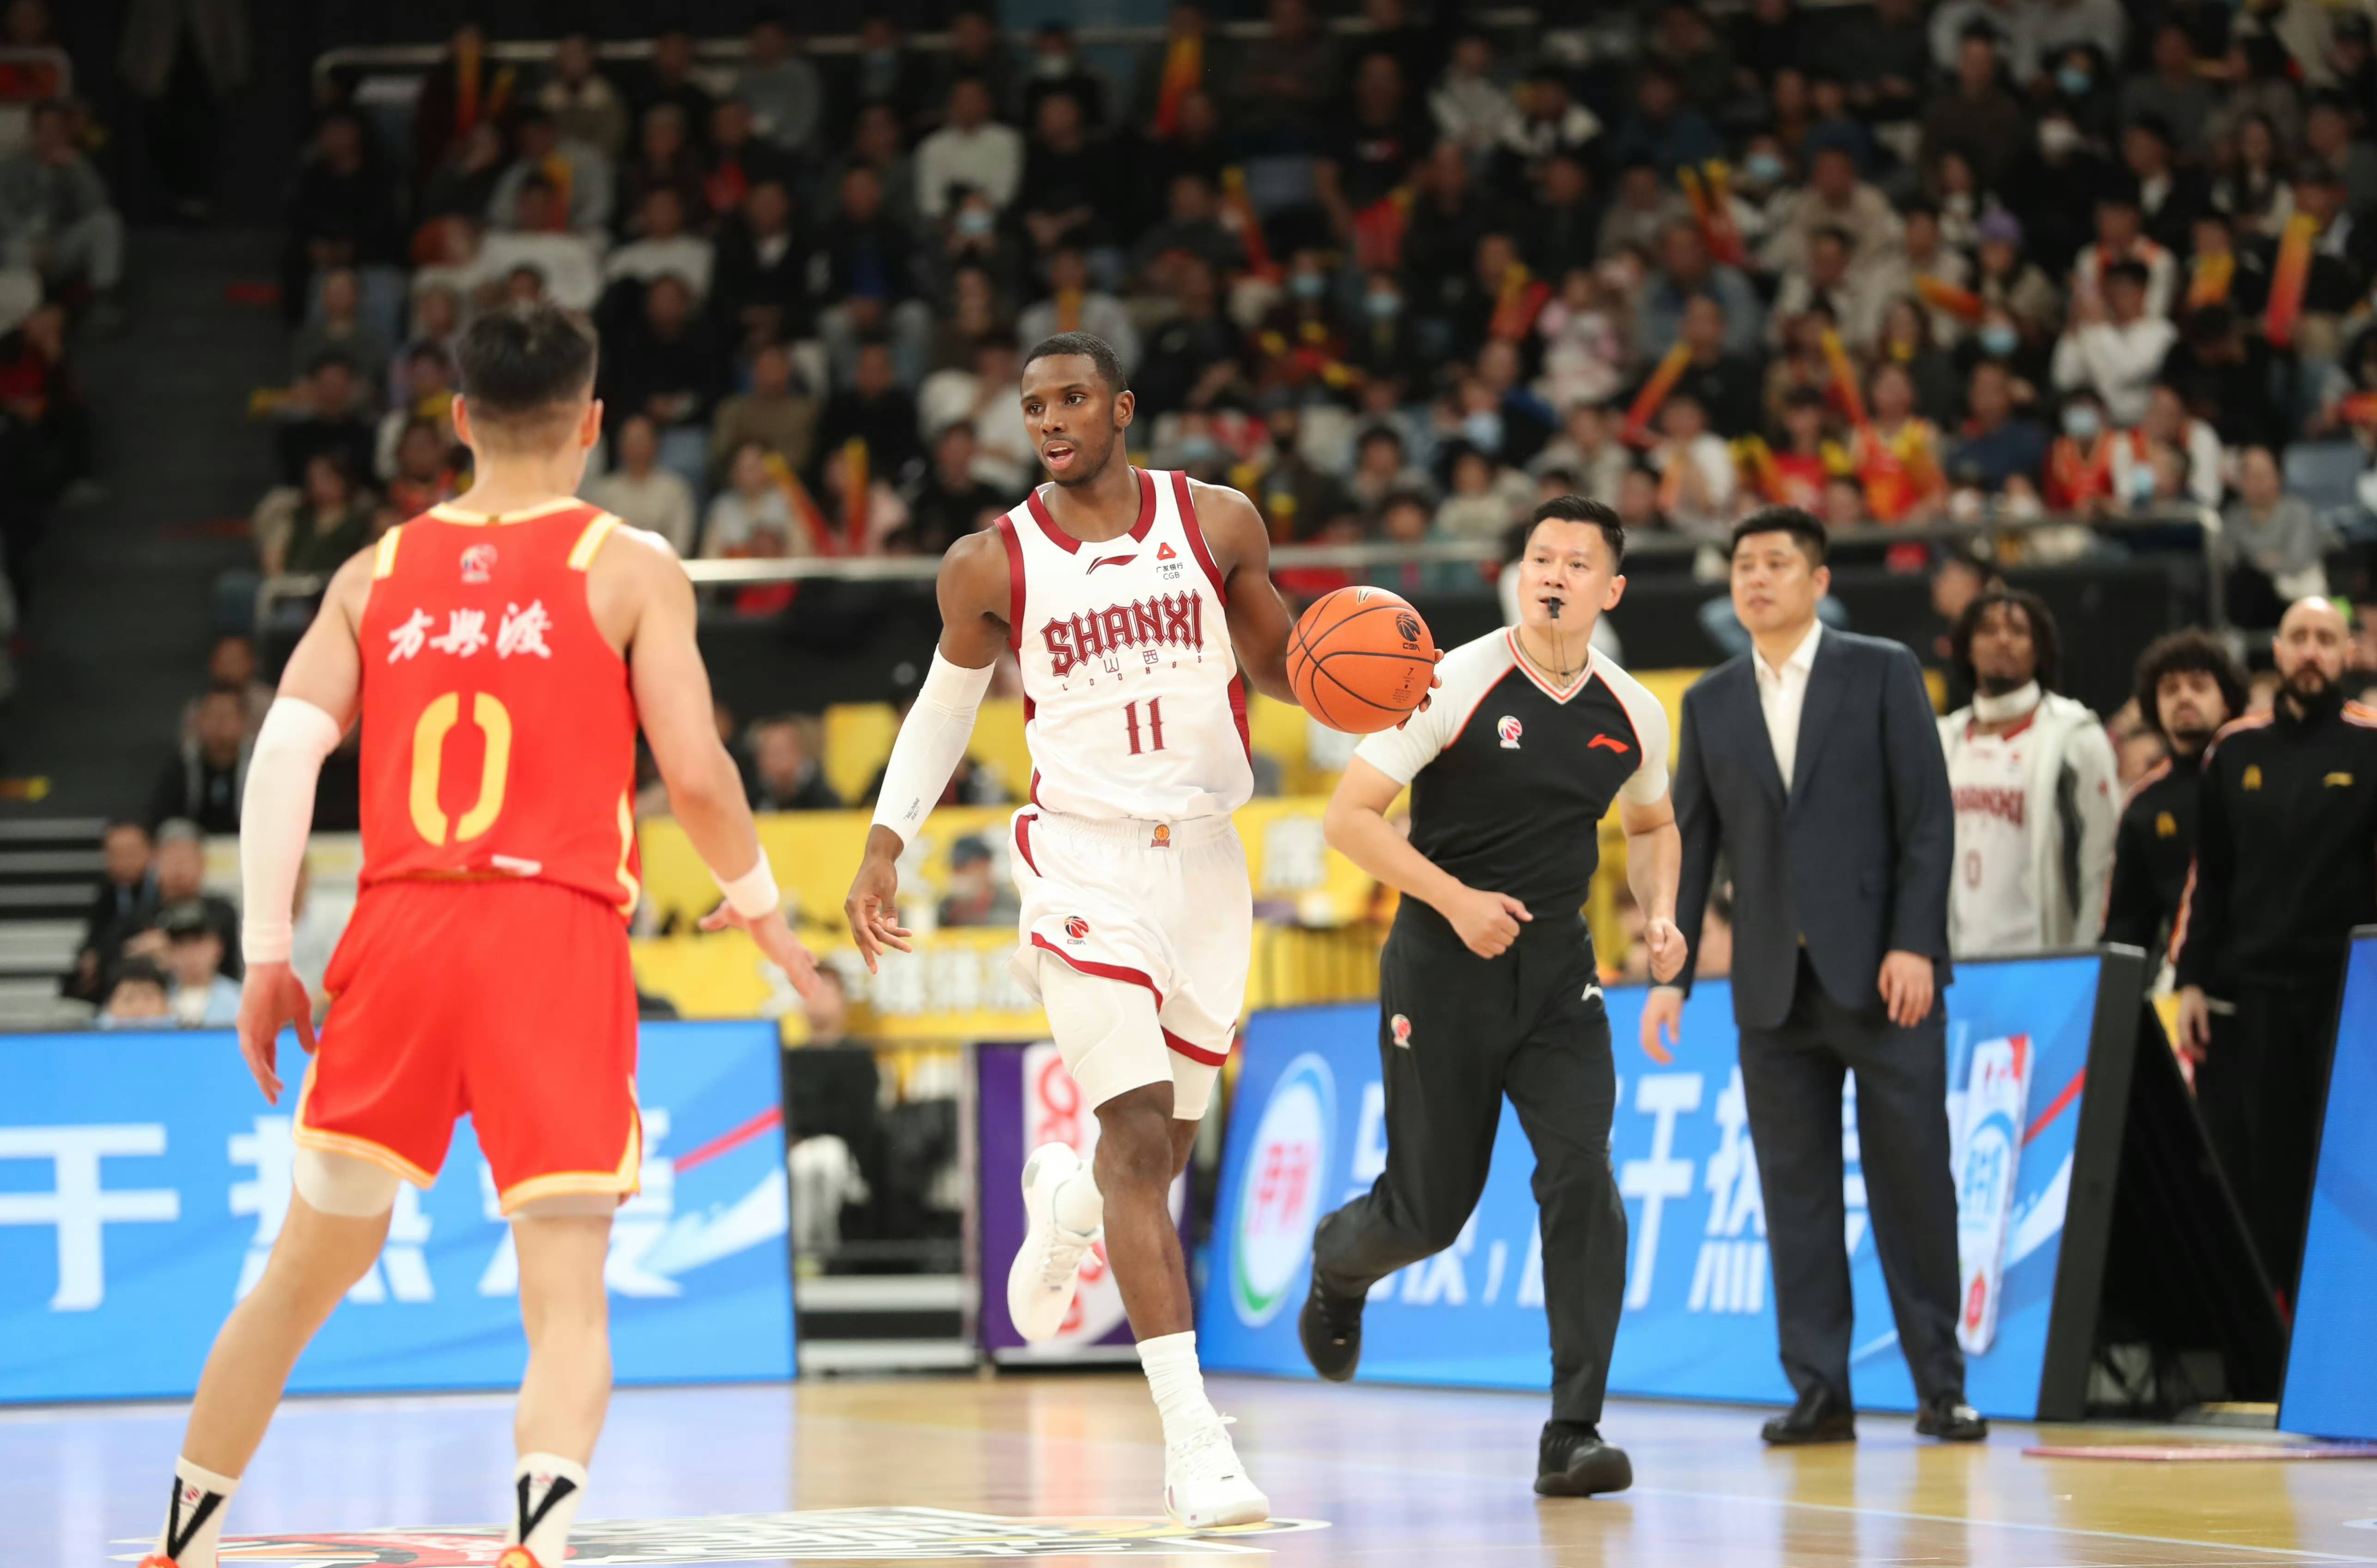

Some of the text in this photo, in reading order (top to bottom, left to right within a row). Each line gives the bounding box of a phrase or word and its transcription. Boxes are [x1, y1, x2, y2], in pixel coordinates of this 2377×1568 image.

[1156, 562, 1183, 573] 广发银行
[1163, 571, 1180, 580] CGB
[1040, 589, 1204, 677] SHANXI
[1403, 642, 1421, 651] CBA
[1408, 667, 1414, 676] 7
[1122, 696, 1167, 756] 11
[409, 691, 512, 847] 0
